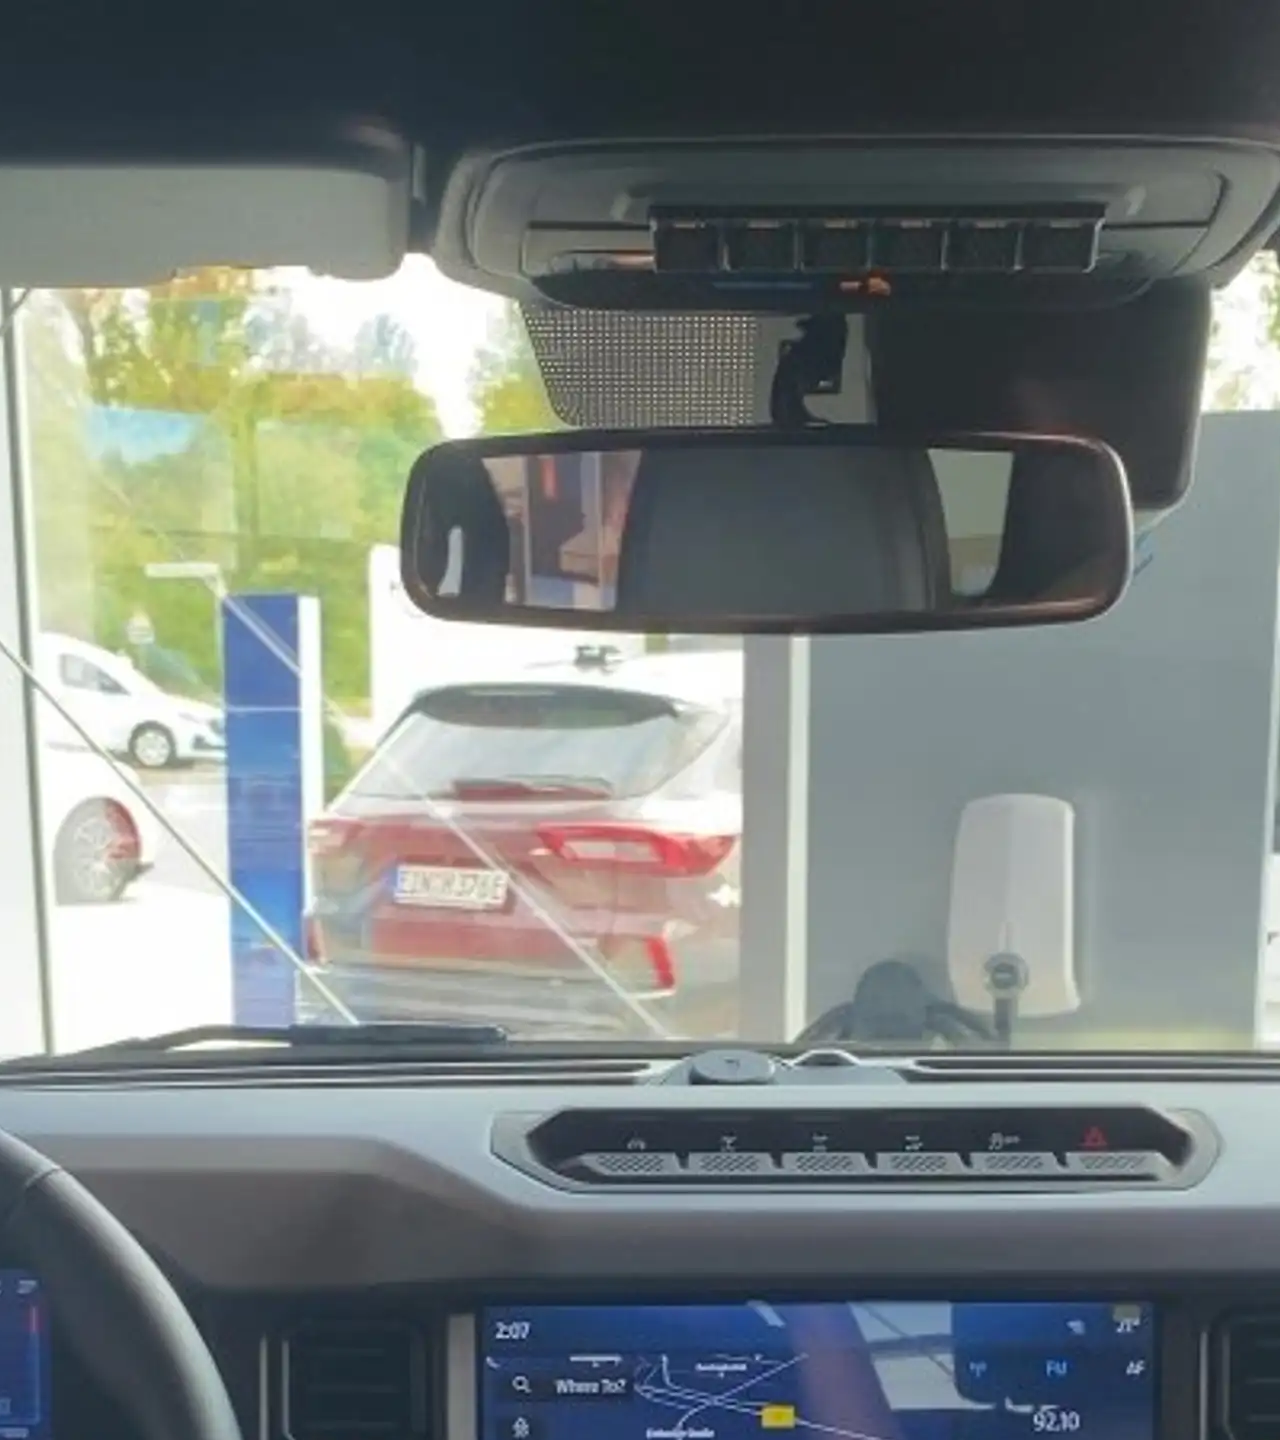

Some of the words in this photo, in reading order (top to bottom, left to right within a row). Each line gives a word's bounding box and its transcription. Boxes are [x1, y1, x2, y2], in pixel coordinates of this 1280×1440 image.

[495, 1321, 531, 1339] 2:07
[555, 1378, 600, 1394] Where
[602, 1378, 627, 1394] To?
[1032, 1411, 1080, 1432] 92.10
